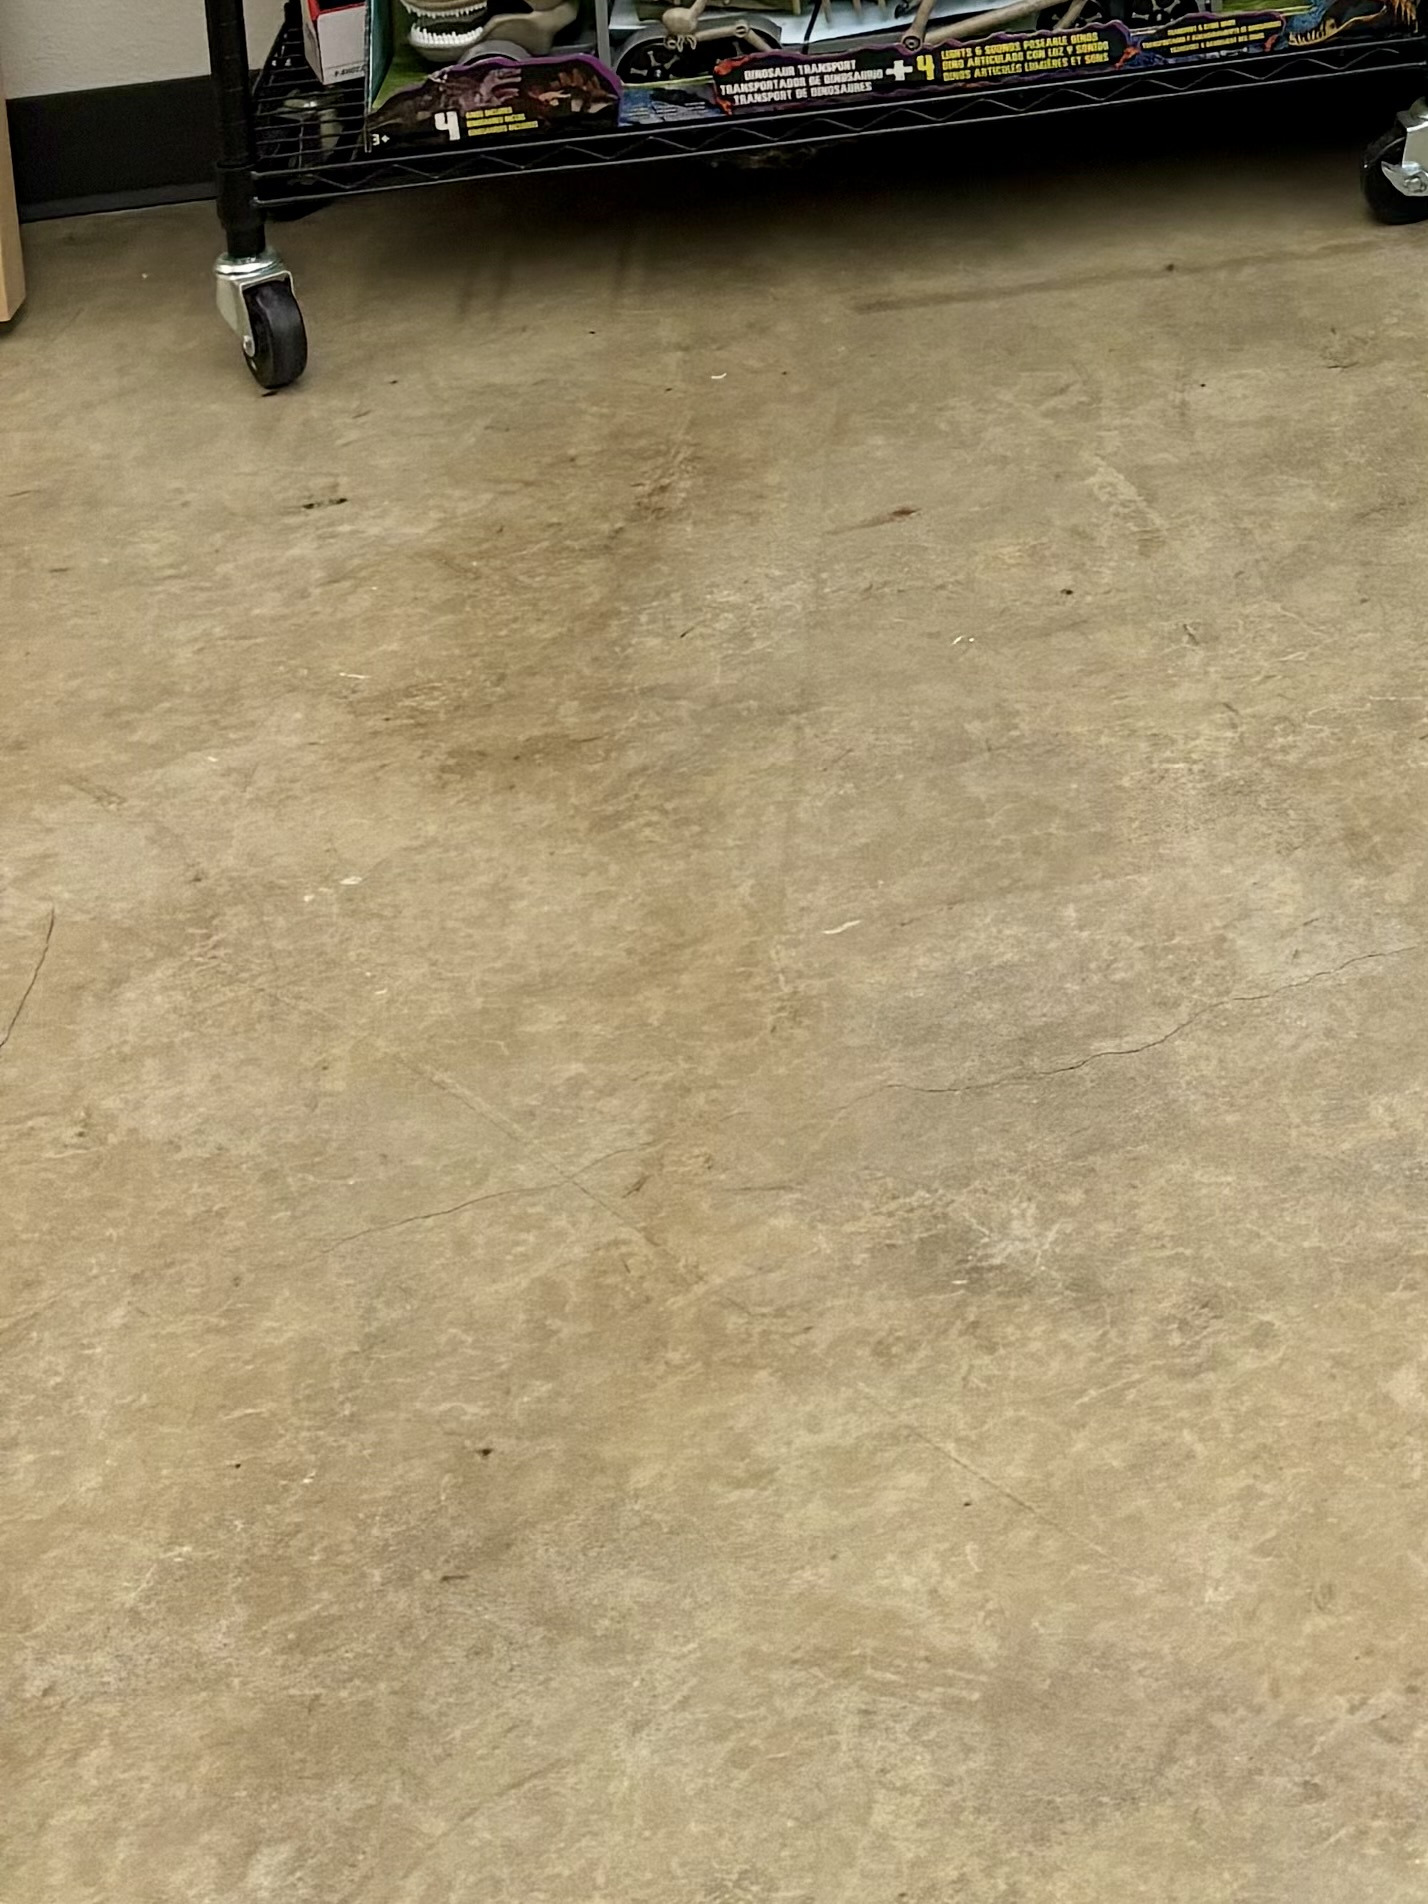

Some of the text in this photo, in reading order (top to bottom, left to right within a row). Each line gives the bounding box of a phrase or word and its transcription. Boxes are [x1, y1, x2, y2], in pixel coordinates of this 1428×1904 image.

[941, 35, 1069, 60] LIGHTS POSEABLE
[1026, 48, 1046, 61] CON
[743, 59, 857, 81] DINOSAUR TRANSPORT
[916, 54, 936, 81] 4
[720, 75, 822, 96] TRANSPORTADOR DE
[733, 81, 873, 107] TRANSPORT DE DINOSAURES
